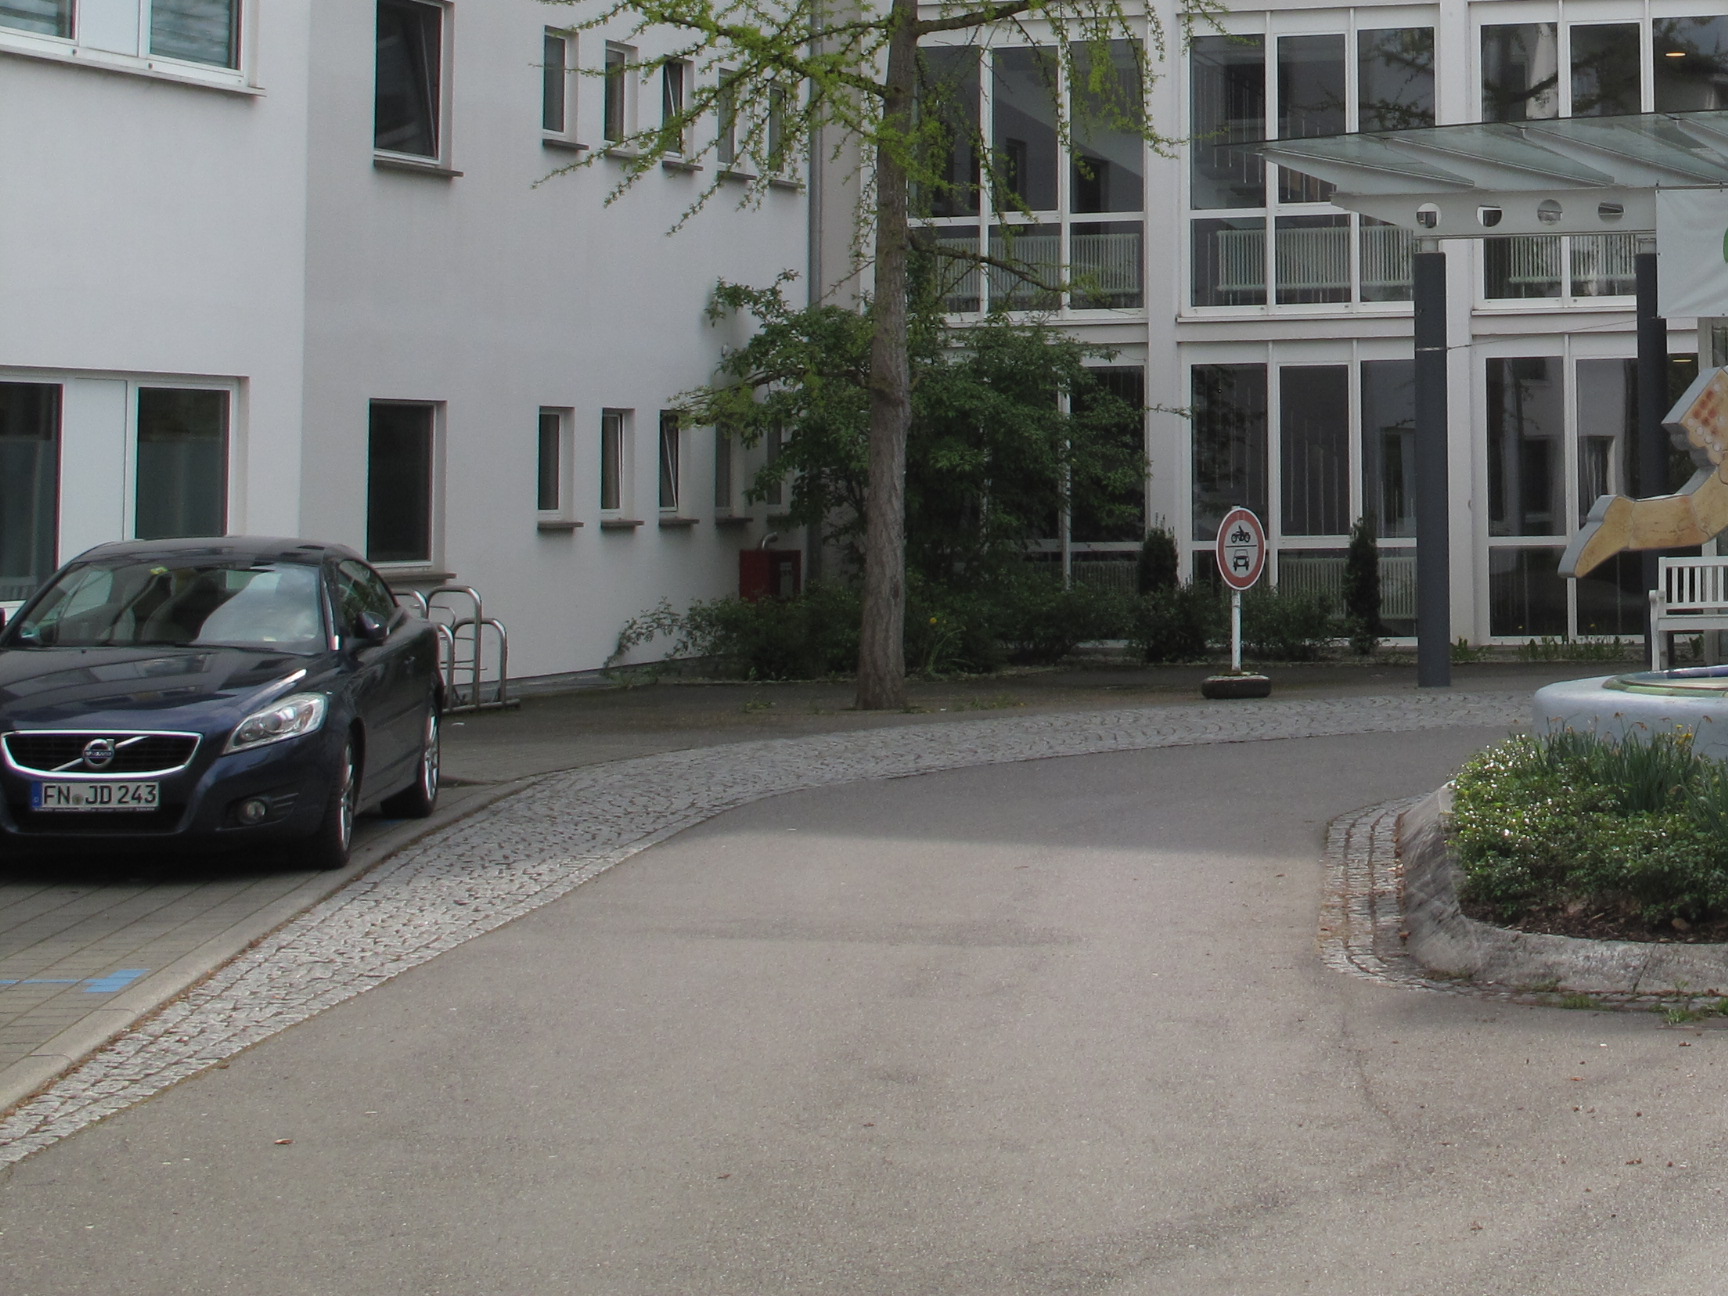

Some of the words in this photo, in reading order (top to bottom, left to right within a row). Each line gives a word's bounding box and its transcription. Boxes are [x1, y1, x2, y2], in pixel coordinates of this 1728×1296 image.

[44, 785, 71, 805] FN
[85, 785, 112, 805] JD
[118, 784, 157, 804] 243
